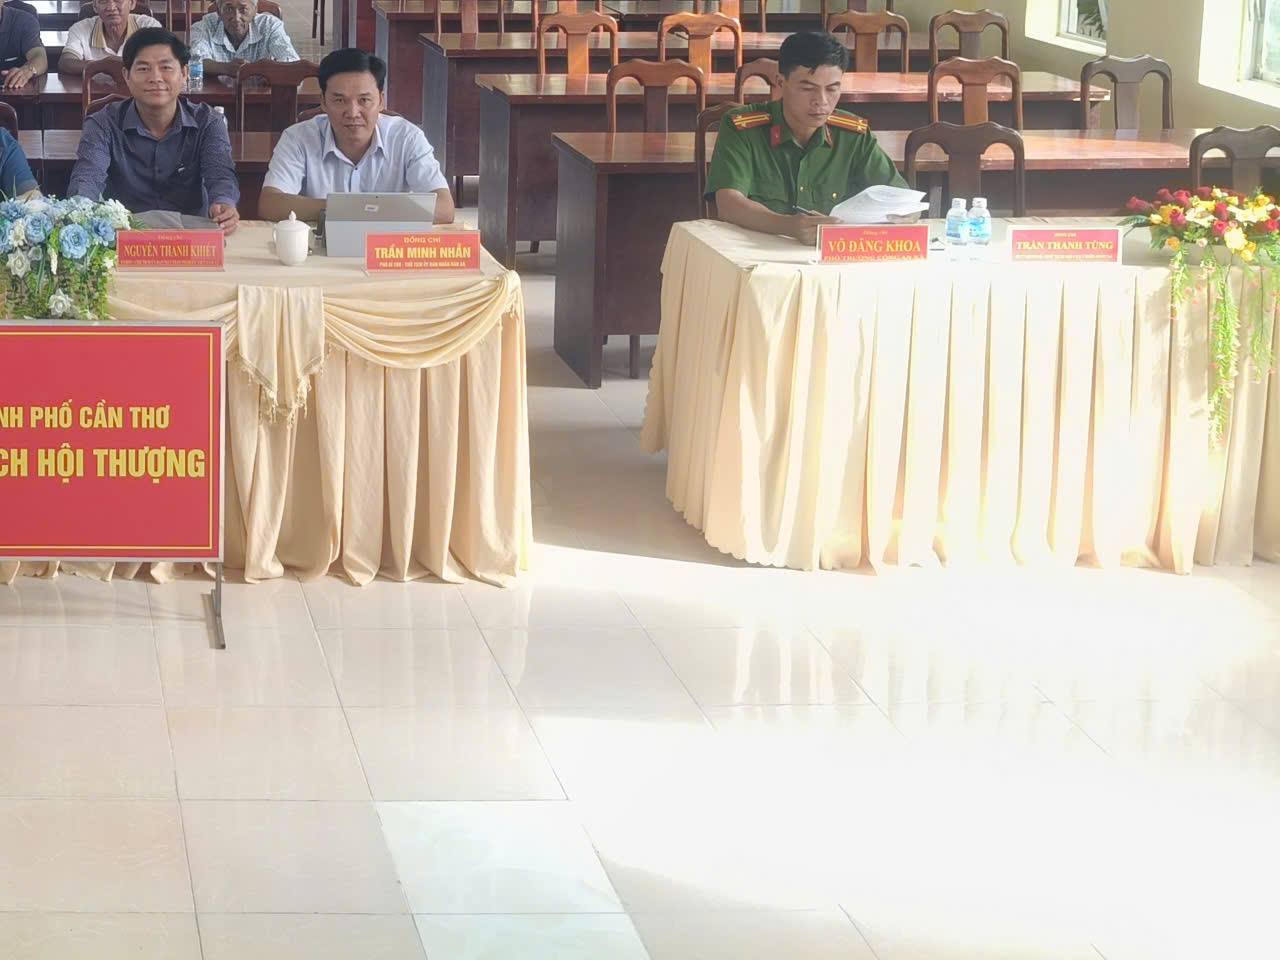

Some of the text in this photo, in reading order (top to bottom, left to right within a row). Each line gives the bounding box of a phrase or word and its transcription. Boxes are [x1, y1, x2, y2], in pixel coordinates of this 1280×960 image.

[407, 247, 436, 258] MINH
[828, 237, 846, 253] VÕ
[886, 239, 921, 252] KHOA
[30, 398, 73, 429] PHỐ
[79, 399, 123, 429] CẦN
[129, 404, 171, 429] THƠ
[37, 442, 84, 484] HỘI
[93, 446, 206, 484] THƯỢNG
